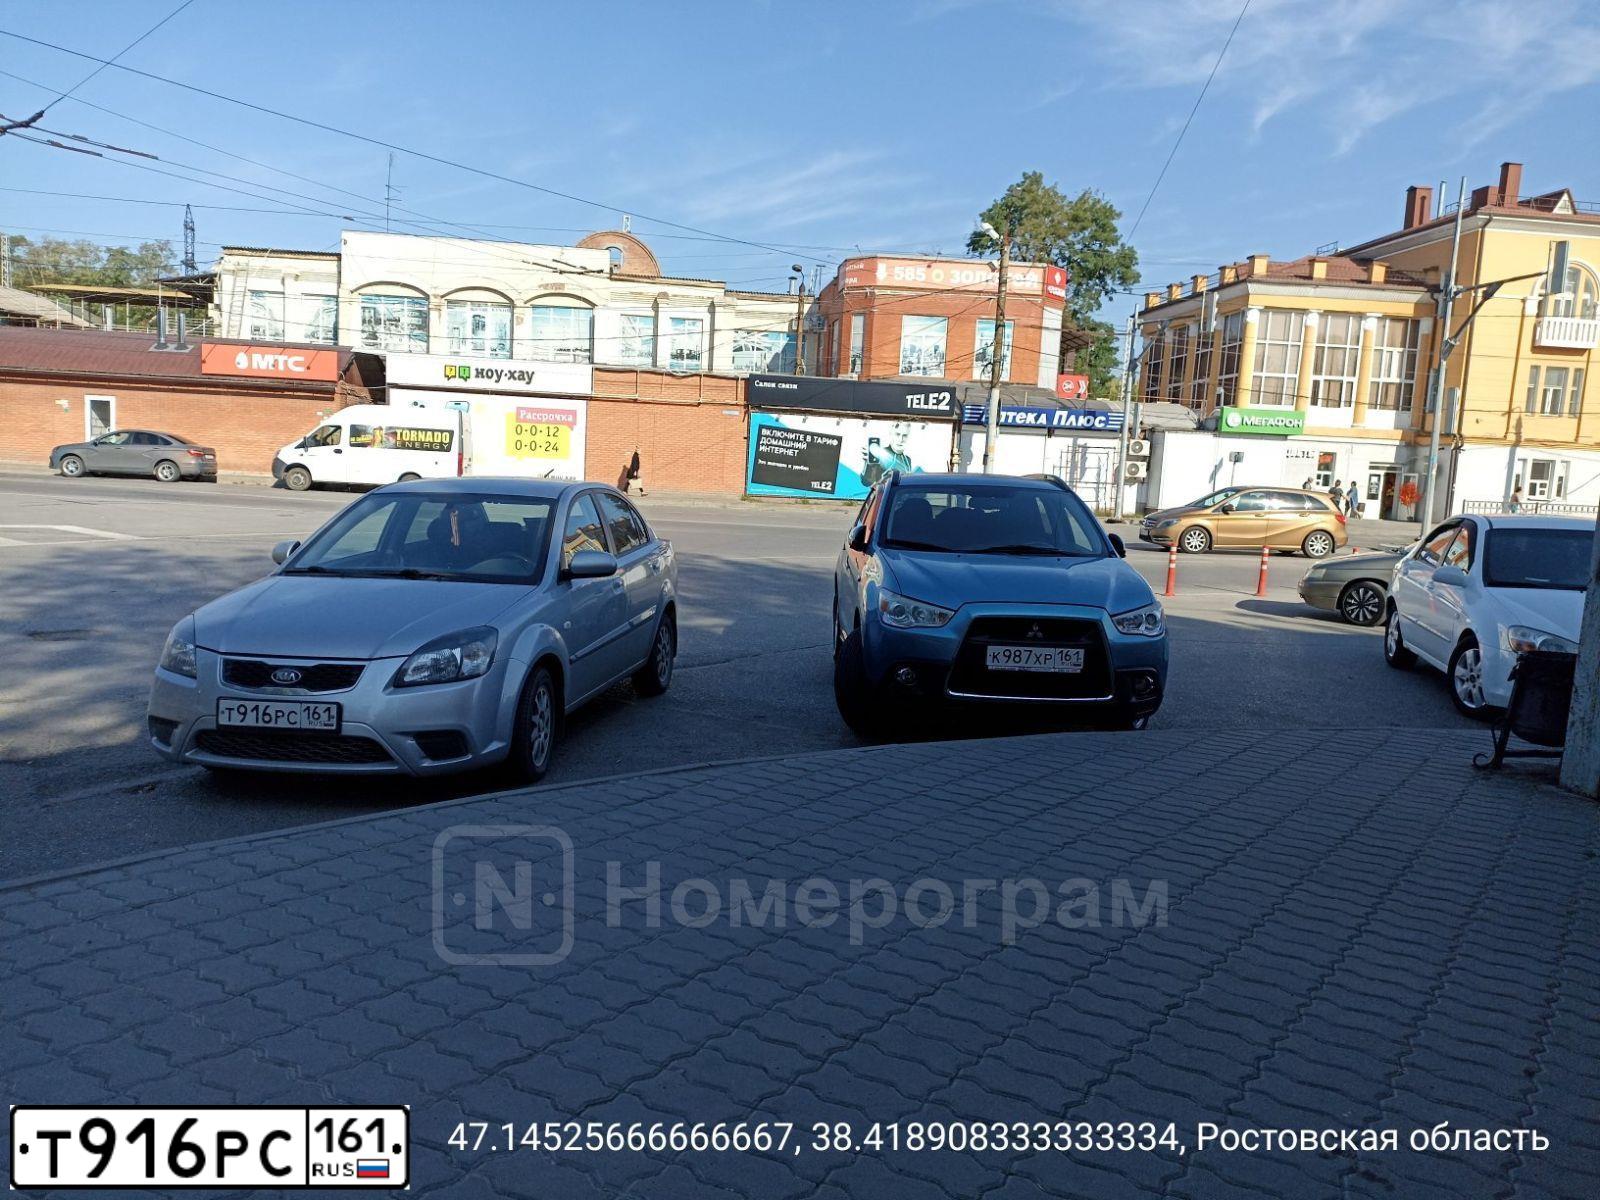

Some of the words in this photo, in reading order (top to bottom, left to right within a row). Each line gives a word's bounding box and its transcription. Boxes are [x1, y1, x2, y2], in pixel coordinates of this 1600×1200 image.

[894, 265, 926, 281] 585
[252, 353, 305, 372] МТС
[754, 380, 776, 388] Салон
[906, 391, 950, 411] TELE2
[519, 409, 574, 422] Рассрочка
[396, 429, 450, 444] TORNADO
[760, 436, 807, 450] ДОМАШНИЙ
[761, 428, 805, 441] ВКЛЮЧИТЕ
[806, 434, 812, 442] В
[813, 436, 839, 446] ТАРИФ
[396, 440, 450, 451] ENERGY
[759, 445, 800, 457] ИНТЕРНЕТ
[810, 481, 832, 490] TELE2
[992, 649, 1053, 665] К987ХР
[1057, 650, 1081, 662] 161
[275, 671, 297, 682] KIA
[225, 703, 298, 725] Т916РС
[303, 705, 332, 722] 161
